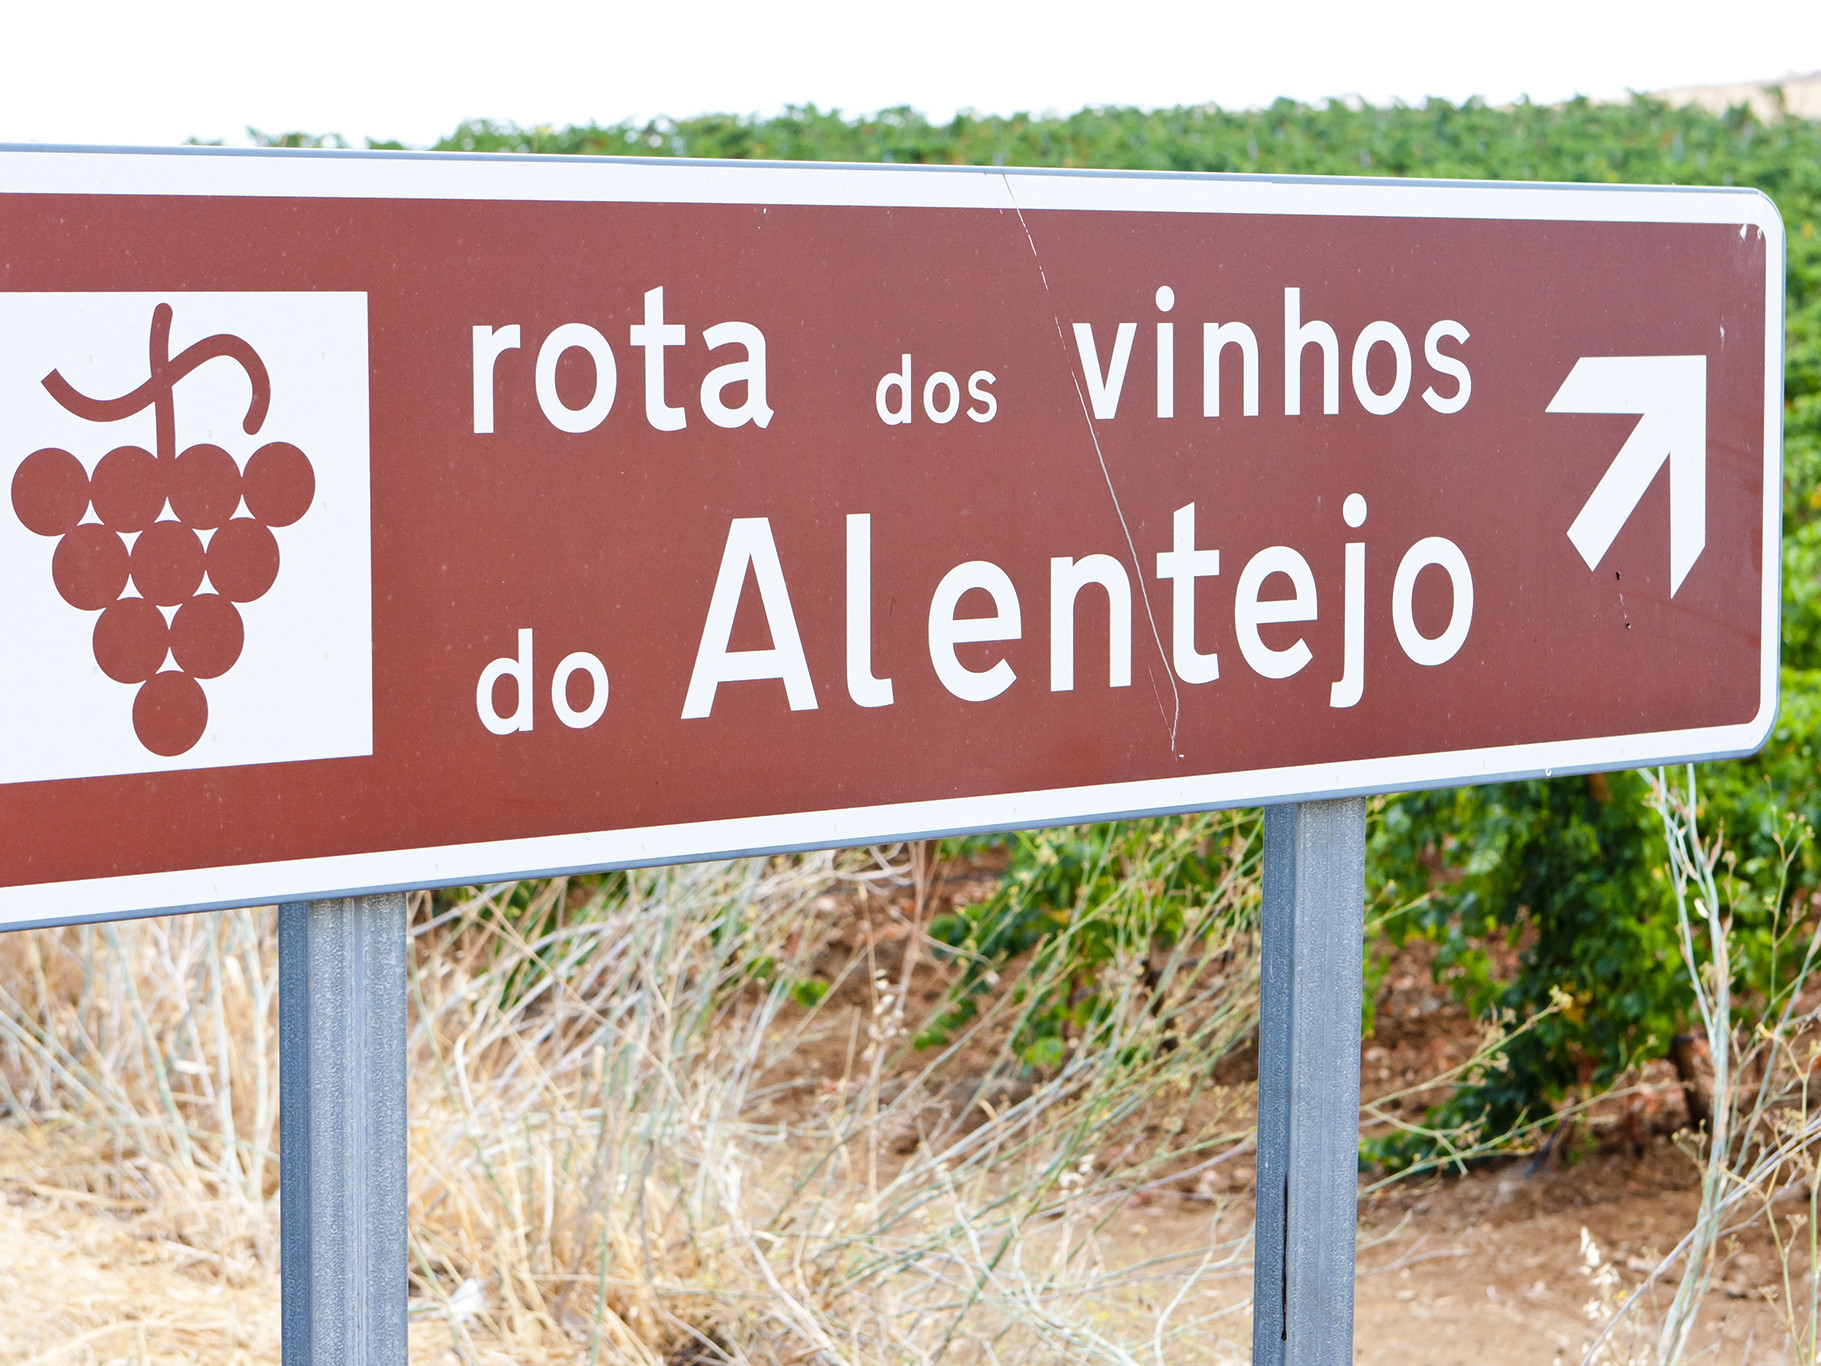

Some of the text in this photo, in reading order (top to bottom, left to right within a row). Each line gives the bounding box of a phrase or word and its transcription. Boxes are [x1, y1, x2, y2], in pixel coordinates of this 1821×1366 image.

[472, 285, 1473, 435] rota dos vinhos
[476, 493, 1474, 736] do Alentejo
